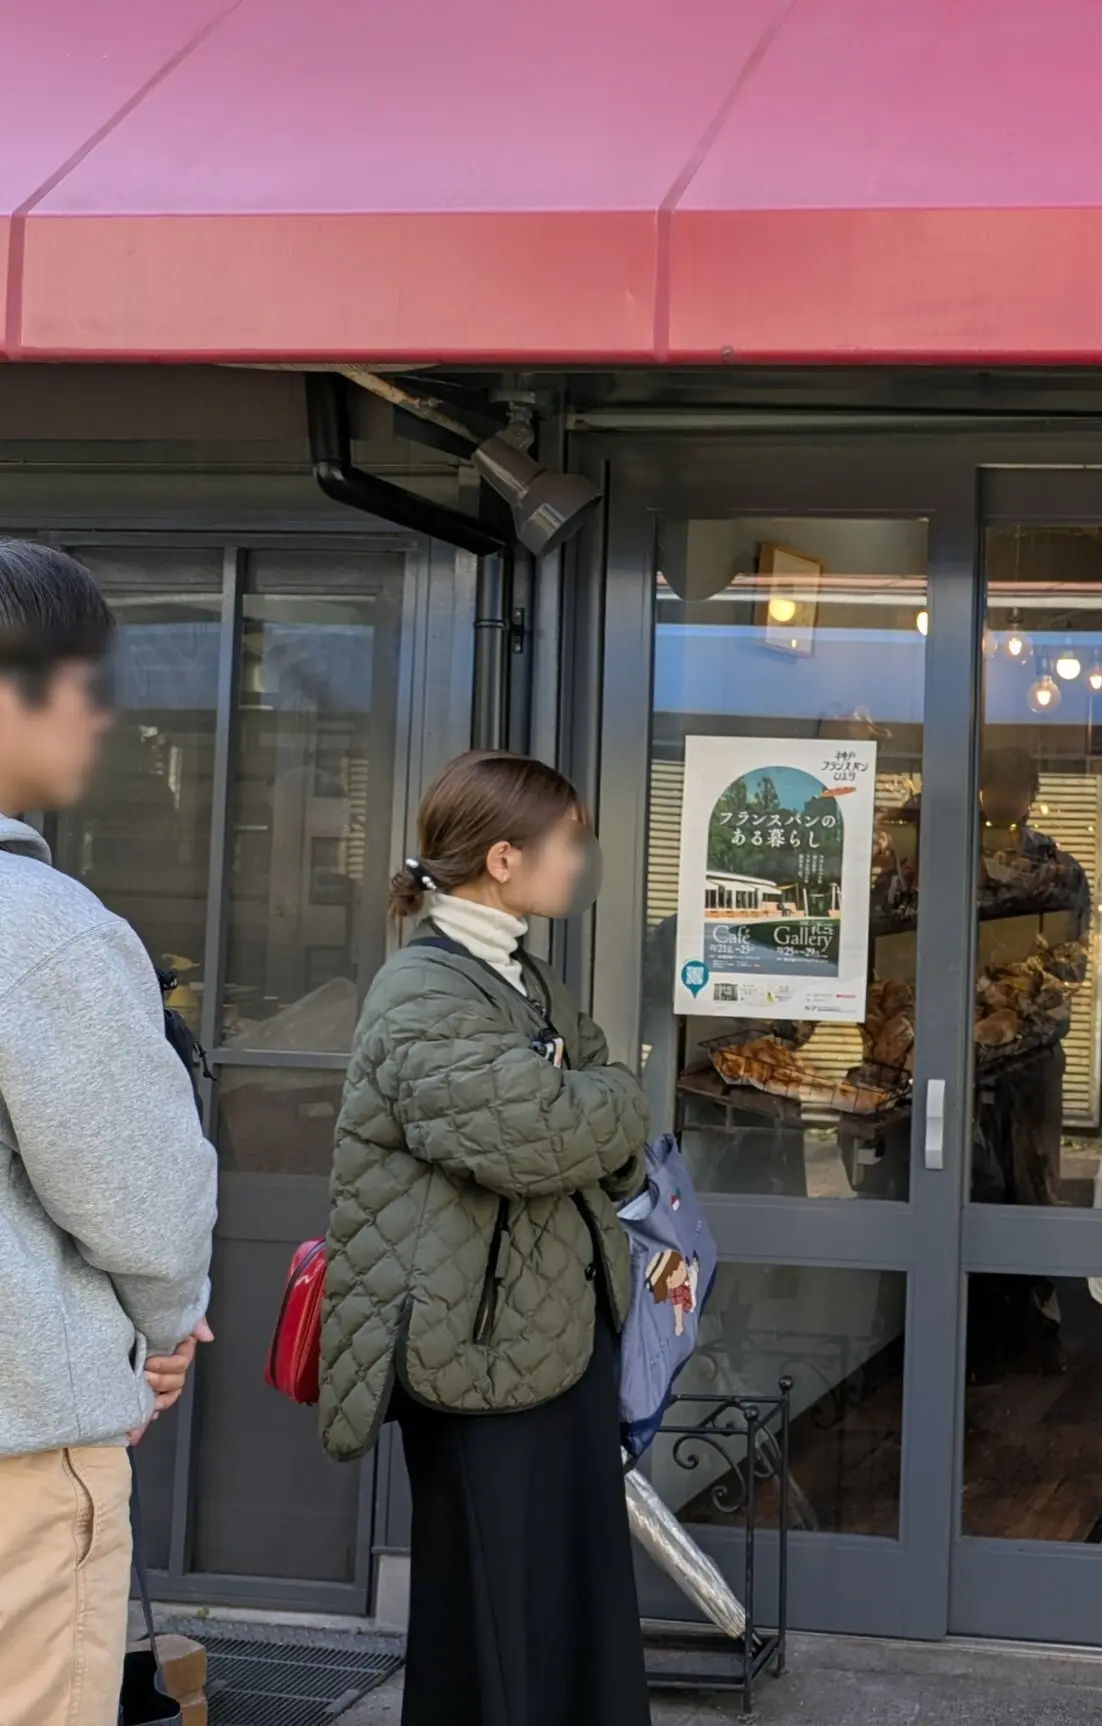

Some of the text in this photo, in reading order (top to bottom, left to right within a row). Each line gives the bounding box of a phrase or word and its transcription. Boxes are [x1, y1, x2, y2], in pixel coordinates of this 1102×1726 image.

[719, 811, 836, 829] フランスパンの
[731, 828, 821, 848] ある暮らし
[713, 925, 751, 944] Café
[773, 926, 834, 952] Gallery
